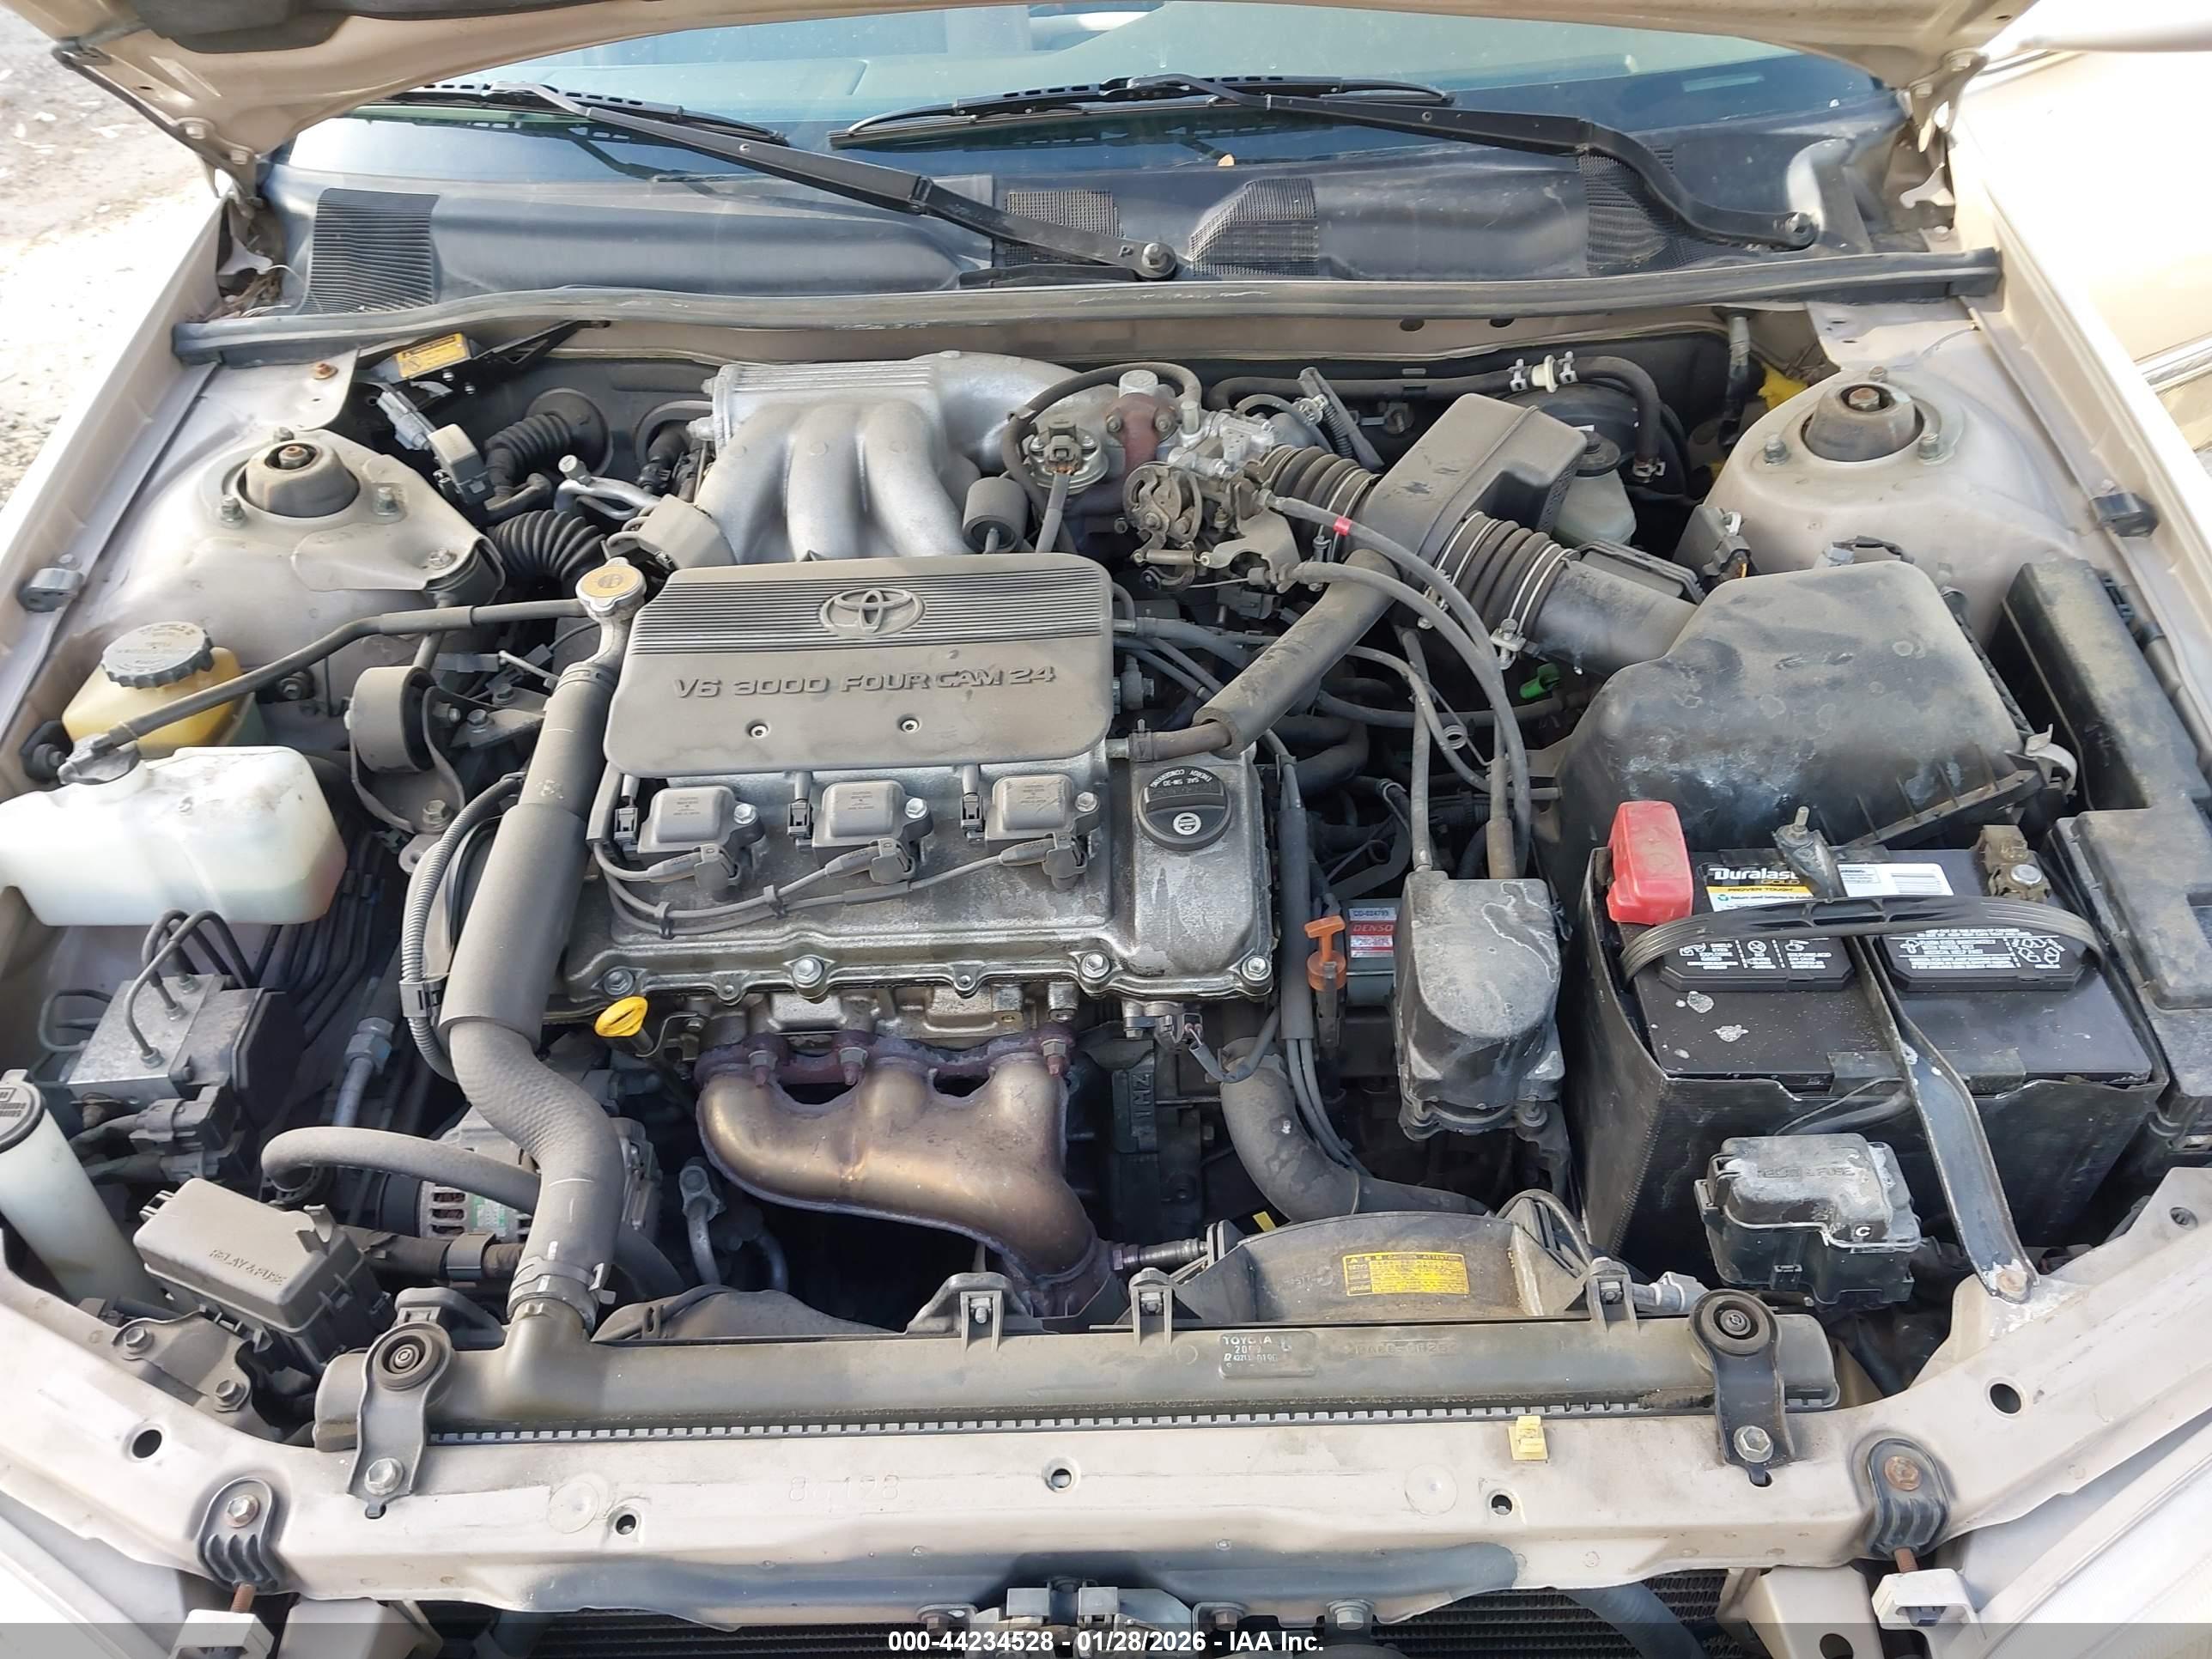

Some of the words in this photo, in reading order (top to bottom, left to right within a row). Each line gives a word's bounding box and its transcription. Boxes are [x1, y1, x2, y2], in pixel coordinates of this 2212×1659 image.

[674, 679, 721, 698] V6
[733, 678, 830, 696] 3000
[840, 672, 933, 693] FOUR
[936, 669, 1002, 690] CAM
[1008, 665, 1056, 685] 24
[1855, 1227, 1871, 1237] C
[210, 1249, 248, 1268] RELAY
